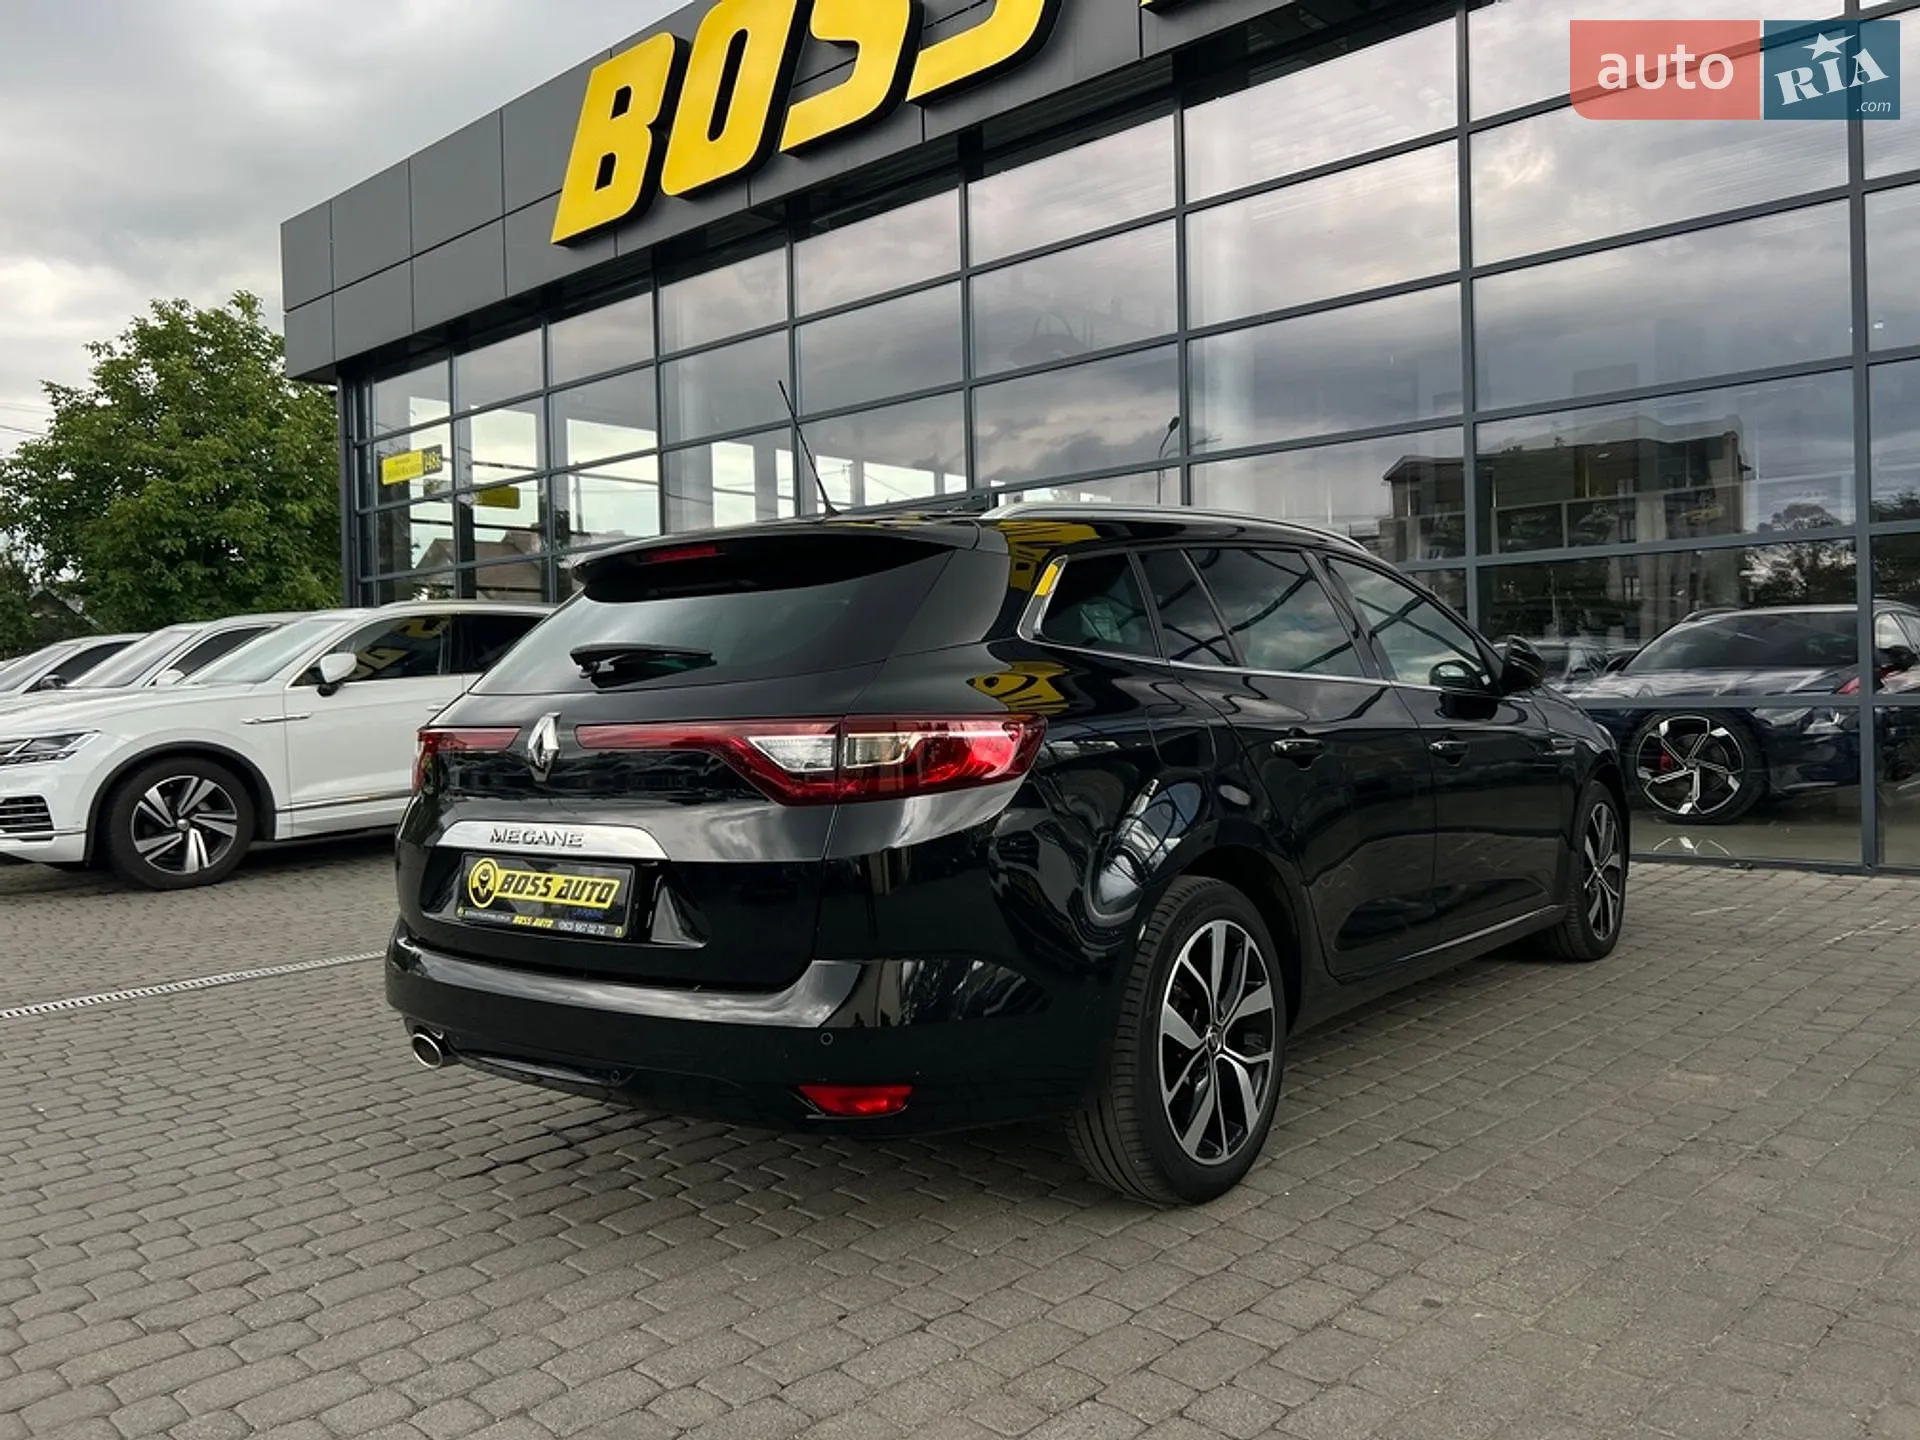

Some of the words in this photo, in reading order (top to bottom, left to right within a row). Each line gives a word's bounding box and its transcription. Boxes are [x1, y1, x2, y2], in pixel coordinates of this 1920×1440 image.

[489, 827, 585, 848] MEGANE
[498, 873, 553, 897] BOSS
[554, 877, 616, 904] AUTO
